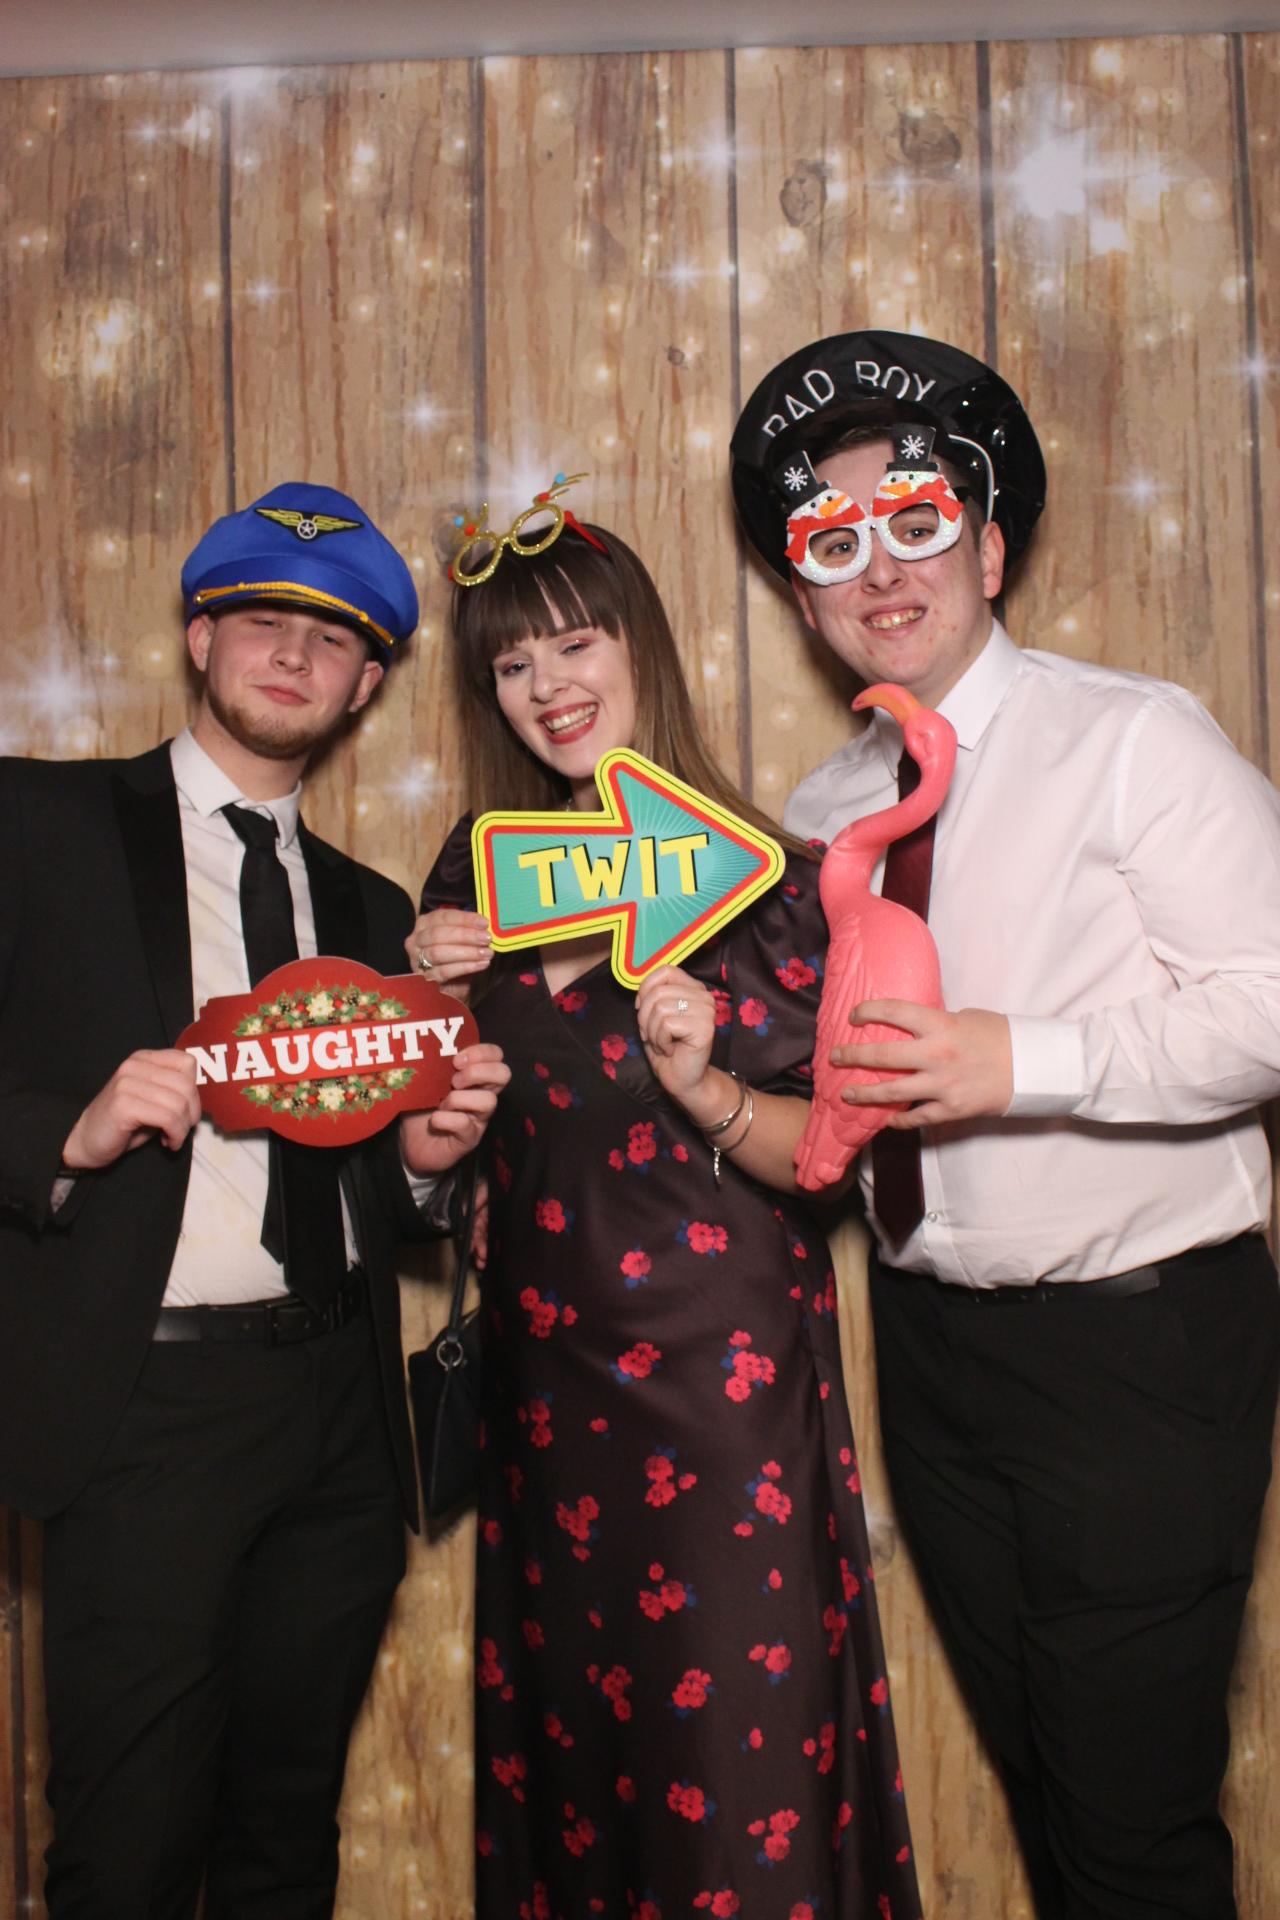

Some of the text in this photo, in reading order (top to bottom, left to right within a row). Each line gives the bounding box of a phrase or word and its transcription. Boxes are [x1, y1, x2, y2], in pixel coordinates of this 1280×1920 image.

[855, 360, 937, 402] BOY
[517, 832, 710, 908] TWIT
[185, 1016, 465, 1085] NAUGHTY
